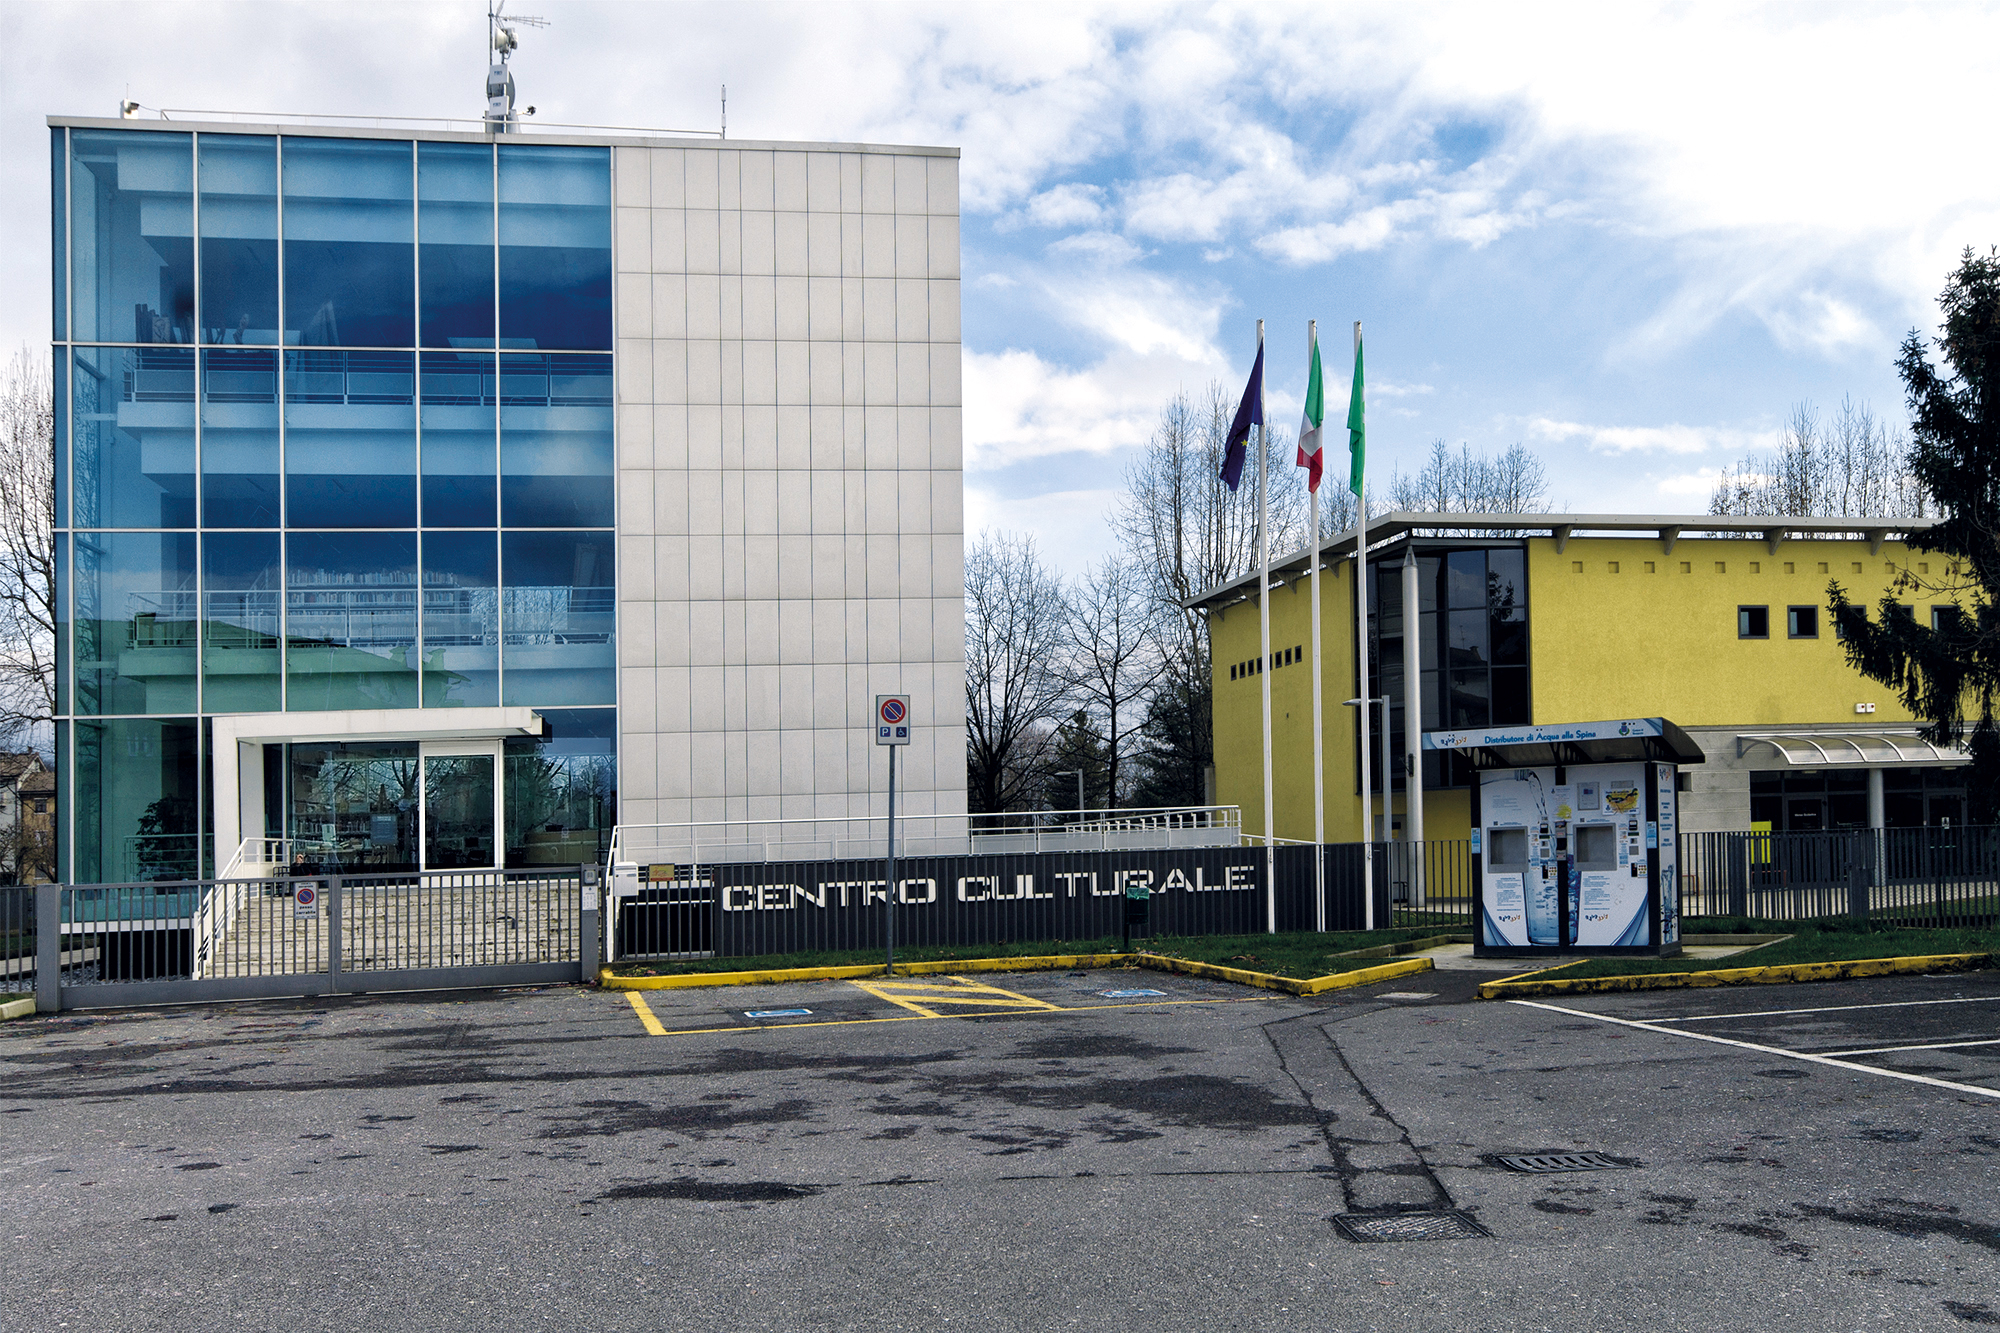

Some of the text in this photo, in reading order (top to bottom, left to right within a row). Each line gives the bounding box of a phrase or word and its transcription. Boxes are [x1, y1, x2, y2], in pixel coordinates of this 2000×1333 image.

[882, 727, 889, 736] P
[1484, 729, 1597, 744] Distributore di Acqua alla Spina
[722, 865, 1256, 912] CENTRO CULTURALE
